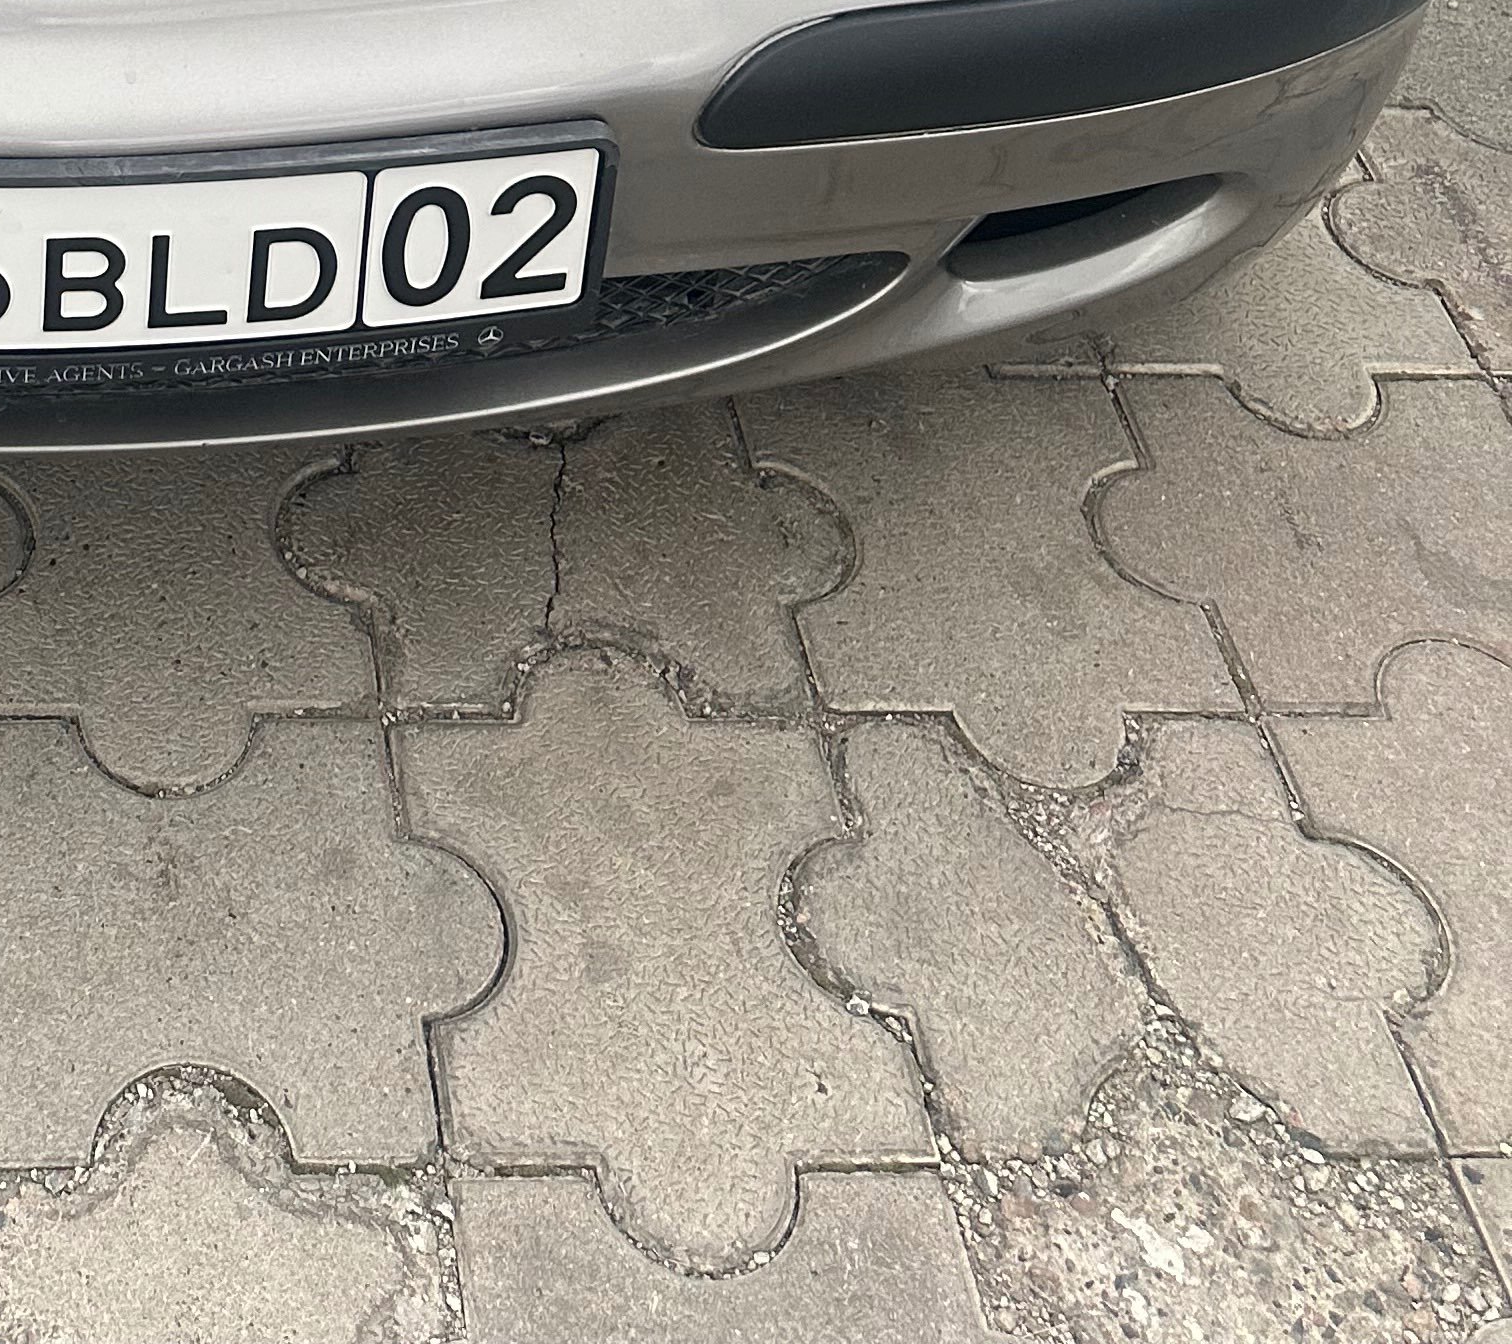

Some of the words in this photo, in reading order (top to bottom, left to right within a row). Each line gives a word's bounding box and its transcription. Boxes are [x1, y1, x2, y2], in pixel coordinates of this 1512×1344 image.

[43, 226, 338, 332] BLD
[381, 174, 578, 307] 02
[46, 363, 144, 384] AGENTS
[174, 352, 293, 377] GARGASH
[300, 333, 460, 366] ENTERPRISES
